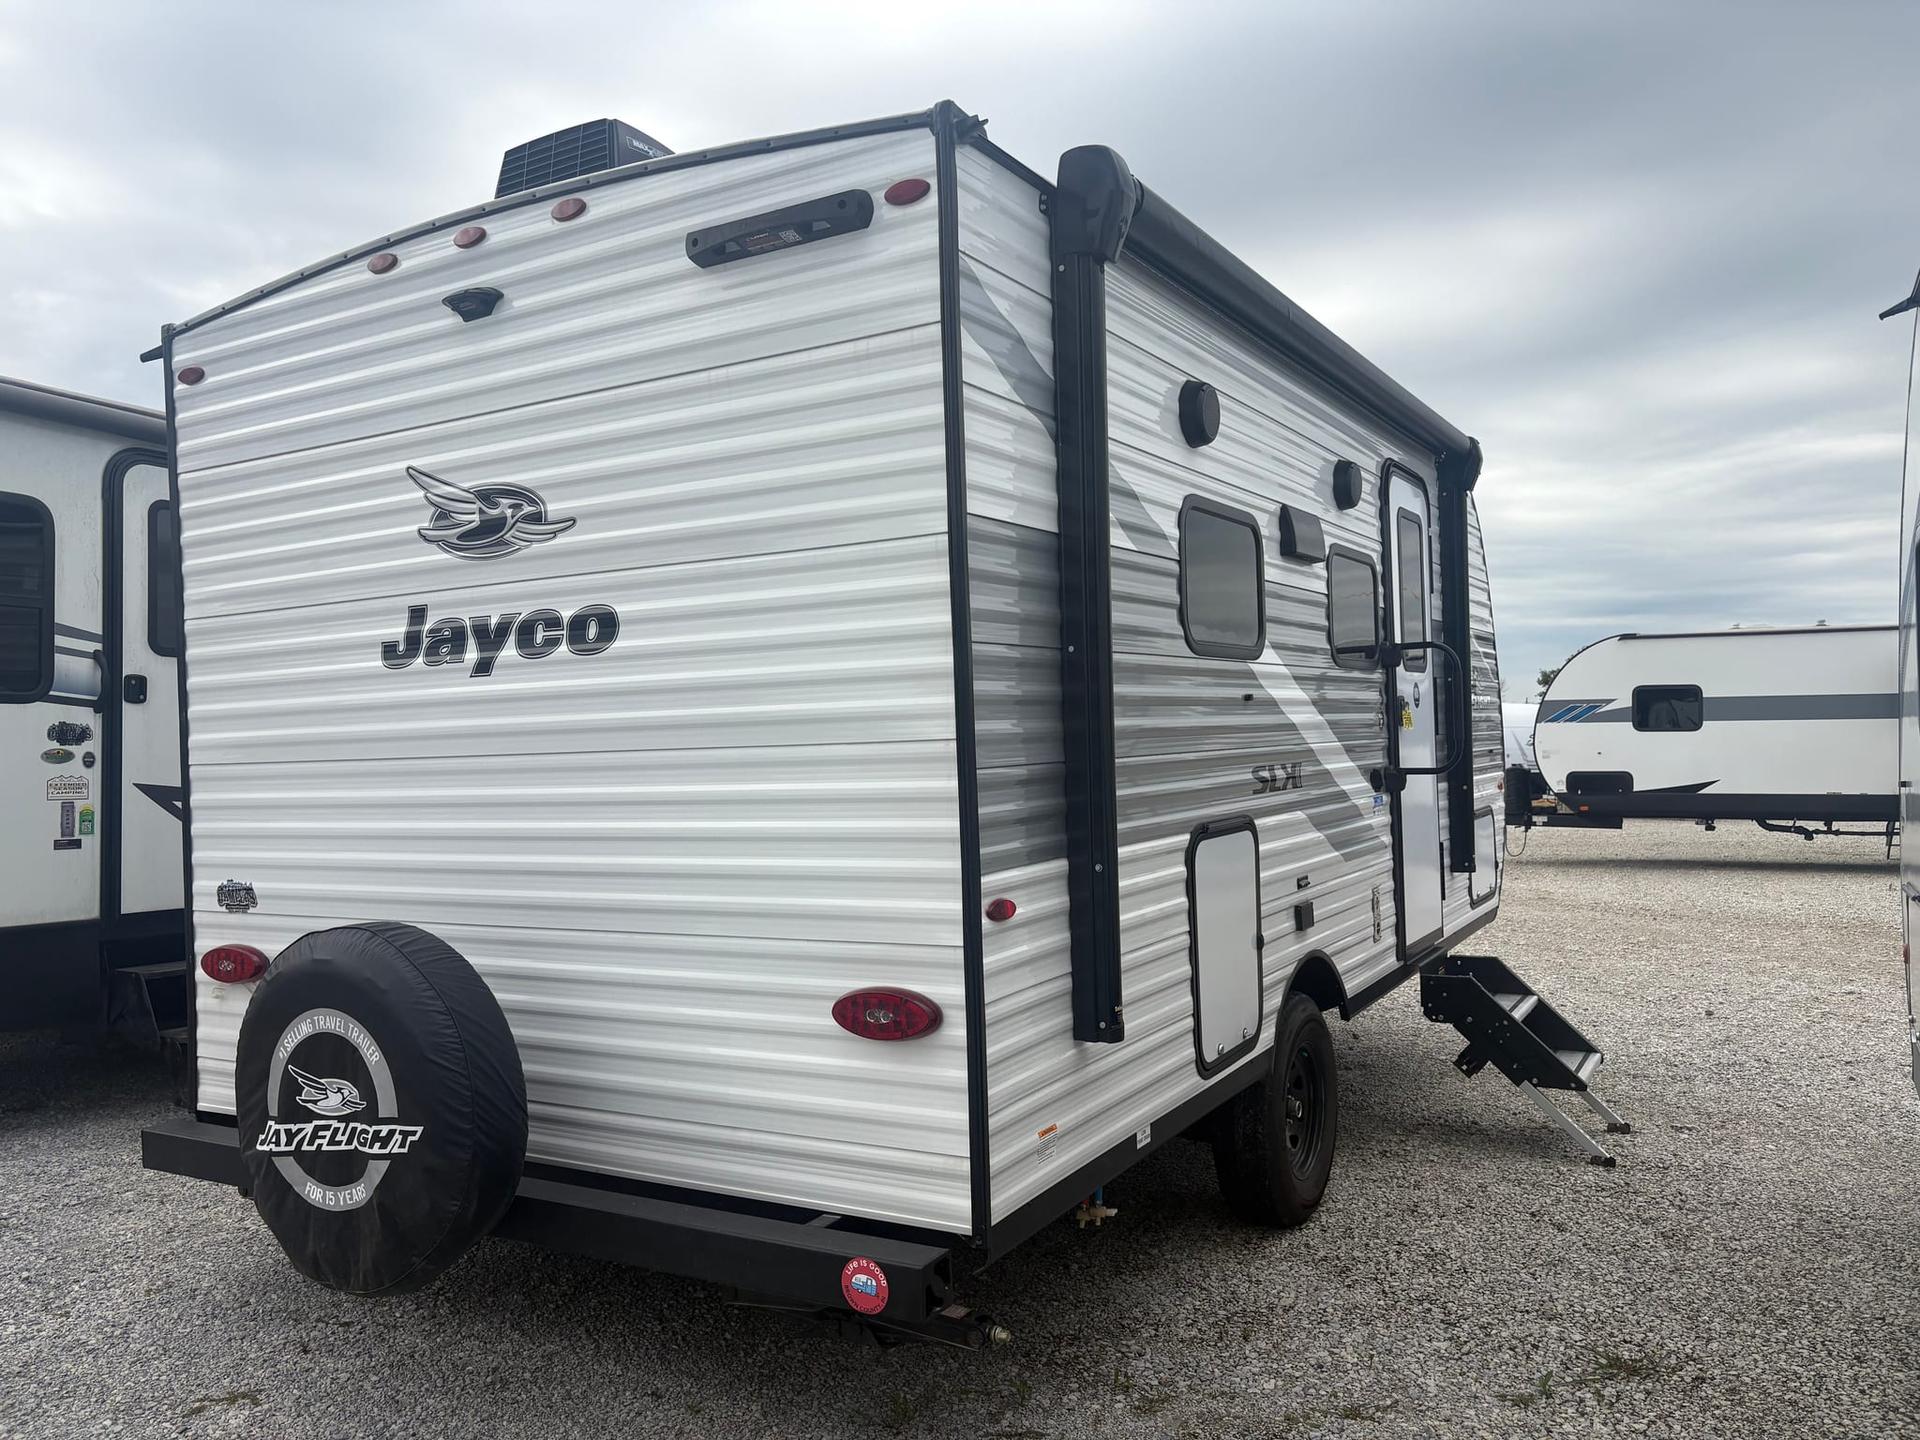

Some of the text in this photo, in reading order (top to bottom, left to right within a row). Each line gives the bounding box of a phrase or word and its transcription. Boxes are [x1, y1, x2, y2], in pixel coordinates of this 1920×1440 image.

[381, 604, 620, 678] Jayco
[283, 1018, 313, 1052] SELLING
[313, 1015, 345, 1034] TRAVEL
[347, 1022, 380, 1065] TRAILER
[304, 1181, 366, 1206] FOR 15 YEARS
[869, 1262, 887, 1287] GOOD
